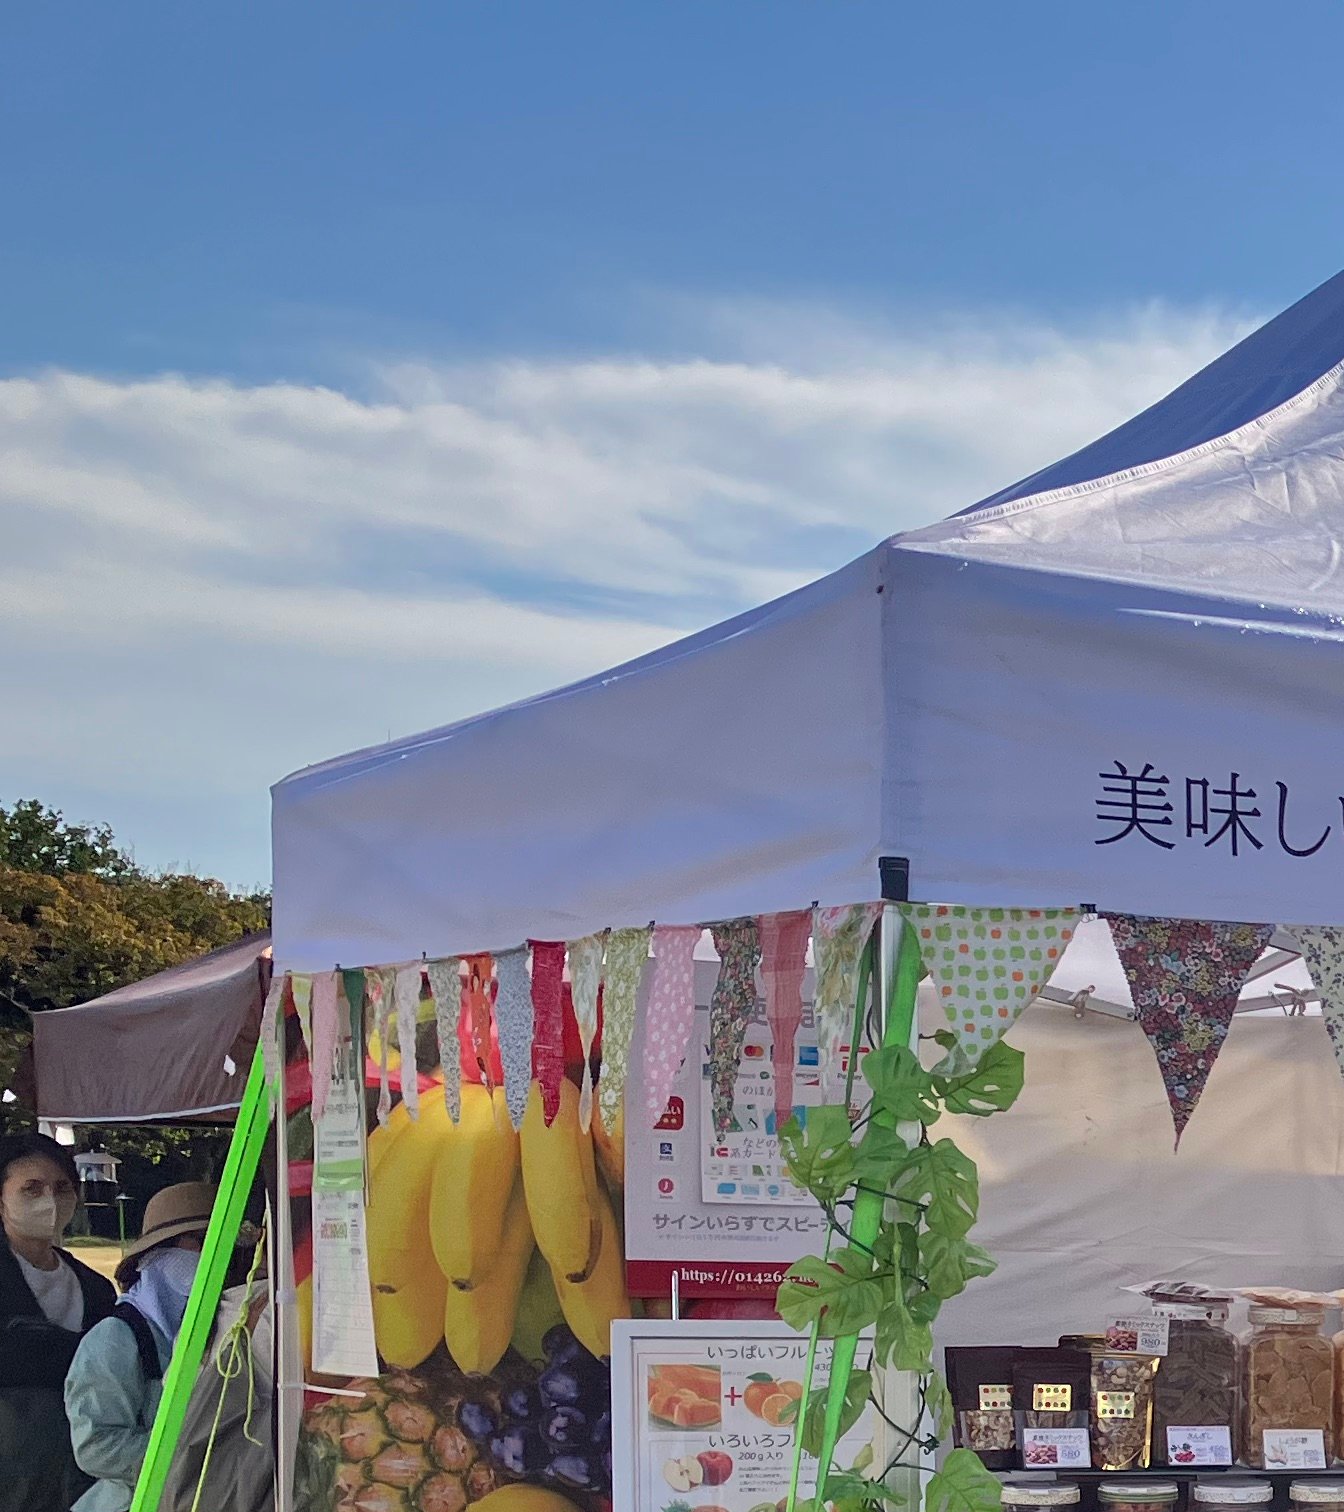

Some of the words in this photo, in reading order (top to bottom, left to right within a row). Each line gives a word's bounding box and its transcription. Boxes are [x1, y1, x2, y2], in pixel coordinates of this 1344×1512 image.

[709, 1434, 797, 1448] いろいろフ
